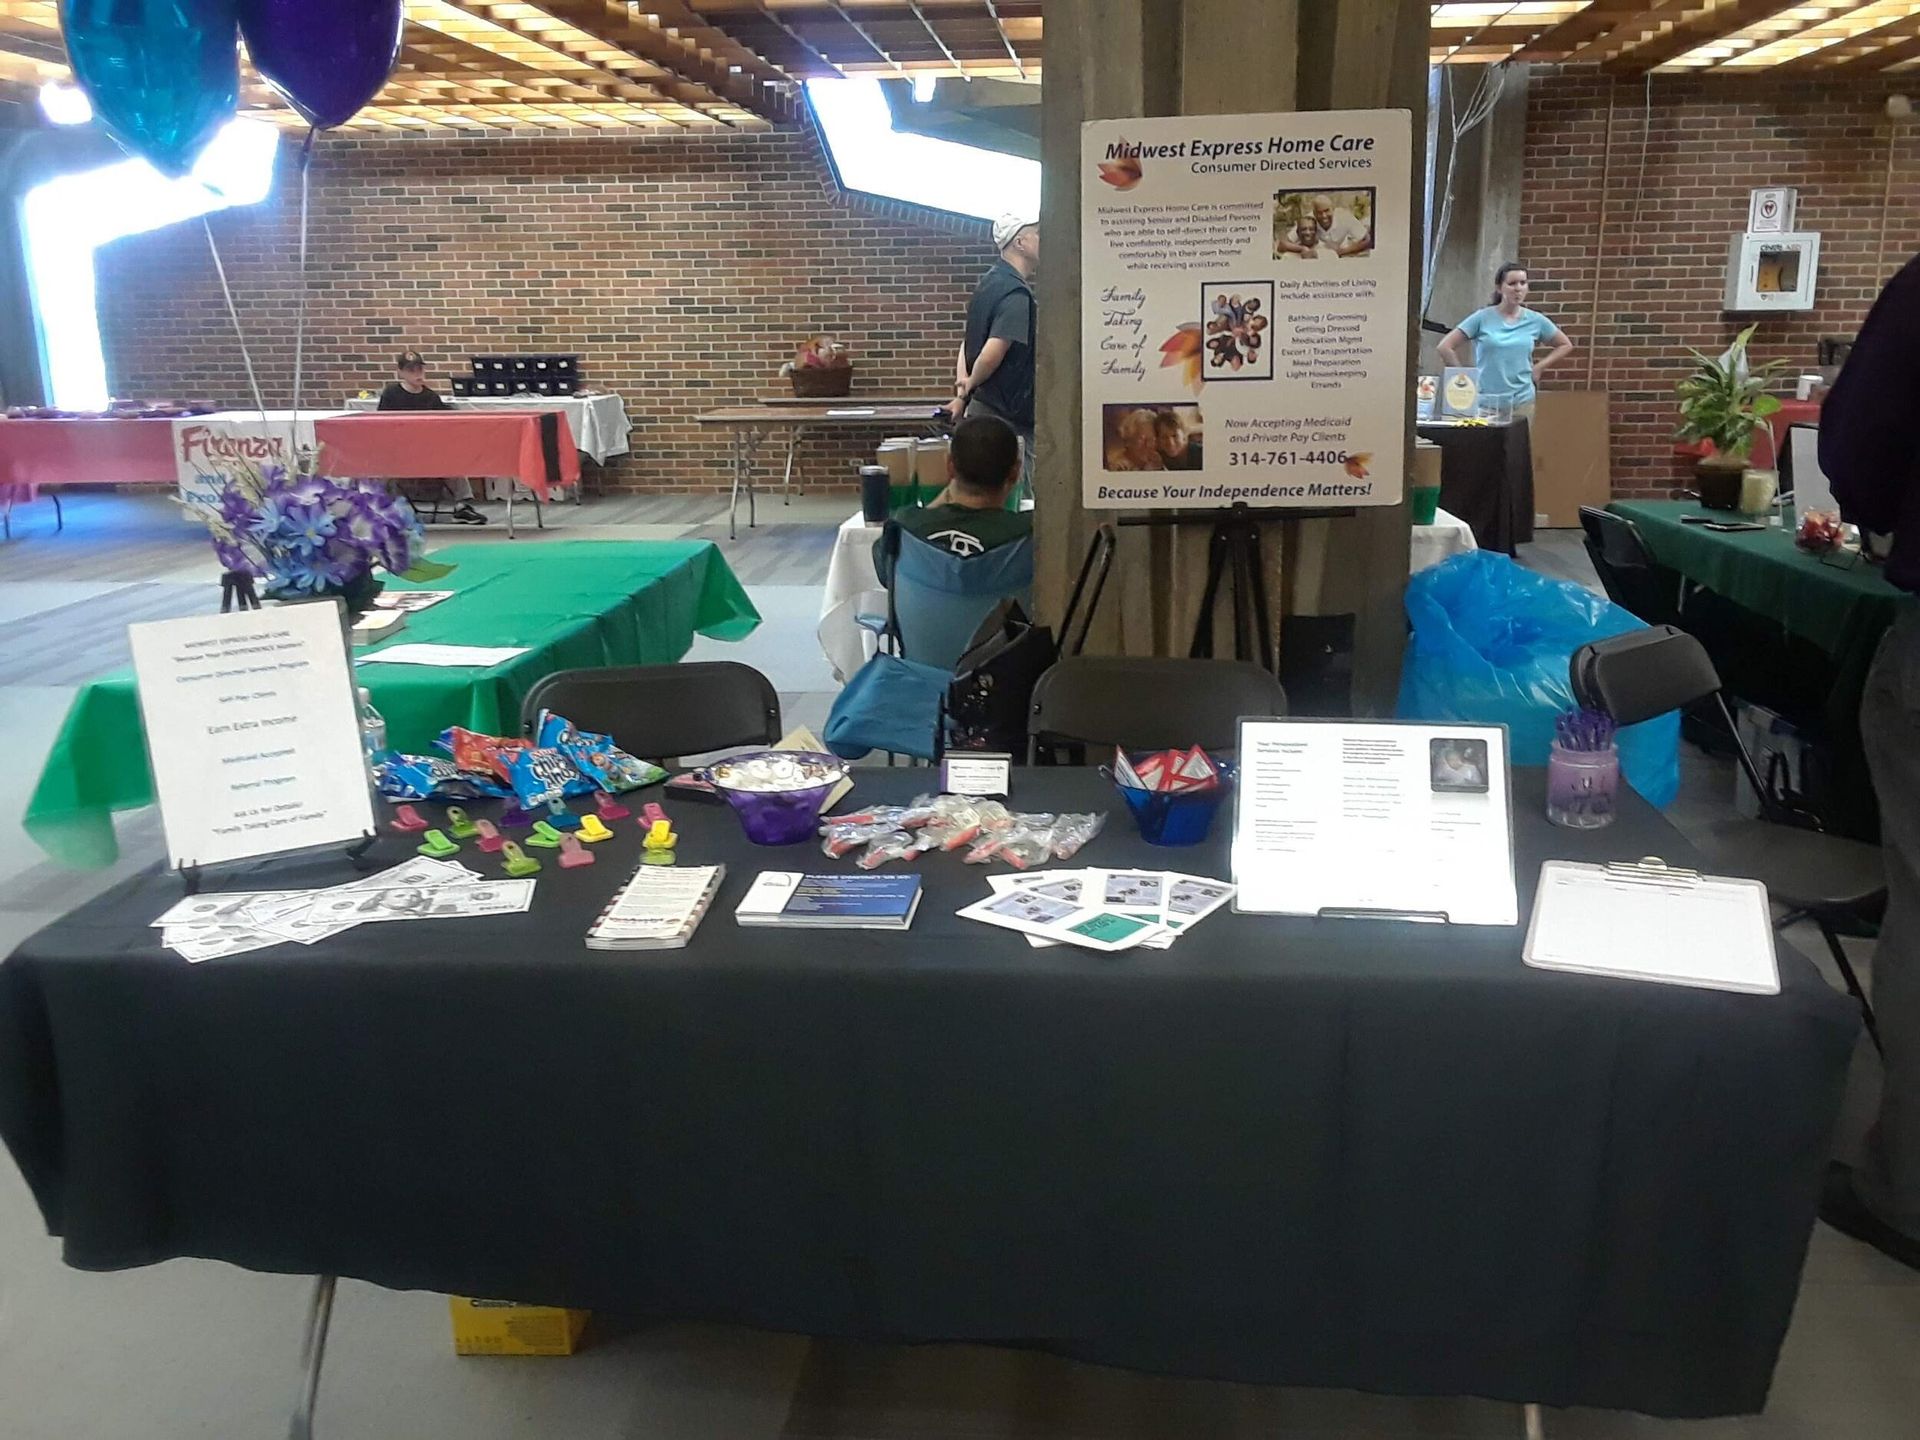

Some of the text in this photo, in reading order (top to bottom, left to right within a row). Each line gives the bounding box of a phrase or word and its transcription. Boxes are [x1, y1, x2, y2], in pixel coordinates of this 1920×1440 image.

[1105, 134, 1375, 160] Midwest Express Home Care
[1191, 156, 1372, 174] Consumer Directed Services
[1098, 206, 1131, 214] Midwest
[1133, 205, 1164, 215] Express
[1191, 204, 1210, 212] Care
[1219, 202, 1264, 210] committed
[1111, 216, 1146, 226] assisting
[1174, 215, 1190, 223] and
[1192, 214, 1227, 223] Disabled
[1229, 213, 1261, 222] Persons
[1104, 229, 1122, 237] who
[1235, 236, 1251, 244] and
[1178, 249, 1197, 257] their
[1218, 248, 1242, 256] home
[1127, 262, 1148, 270] while
[1150, 261, 1187, 271] receiving
[1280, 279, 1377, 290] Daily Activities of Living
[1101, 285, 1146, 309] Family
[1280, 292, 1310, 300] include
[1312, 291, 1353, 299] assistance
[1103, 309, 1143, 335] Taking
[1288, 314, 1319, 323] Bathing
[1295, 324, 1360, 334] Getting Dressed
[1101, 334, 1147, 358] Care of
[1313, 347, 1373, 356] Transportation
[1314, 358, 1362, 367] Preparation
[1101, 358, 1146, 382] Family
[1286, 371, 1307, 379] Light
[1311, 381, 1341, 389] Errands
[1225, 417, 1352, 430] Now Accepting Medicaid
[1229, 431, 1347, 445] and Private Pay Clients
[1228, 450, 1347, 466] 314-761-4406
[1098, 482, 1372, 500] Because Your Independence Matters!
